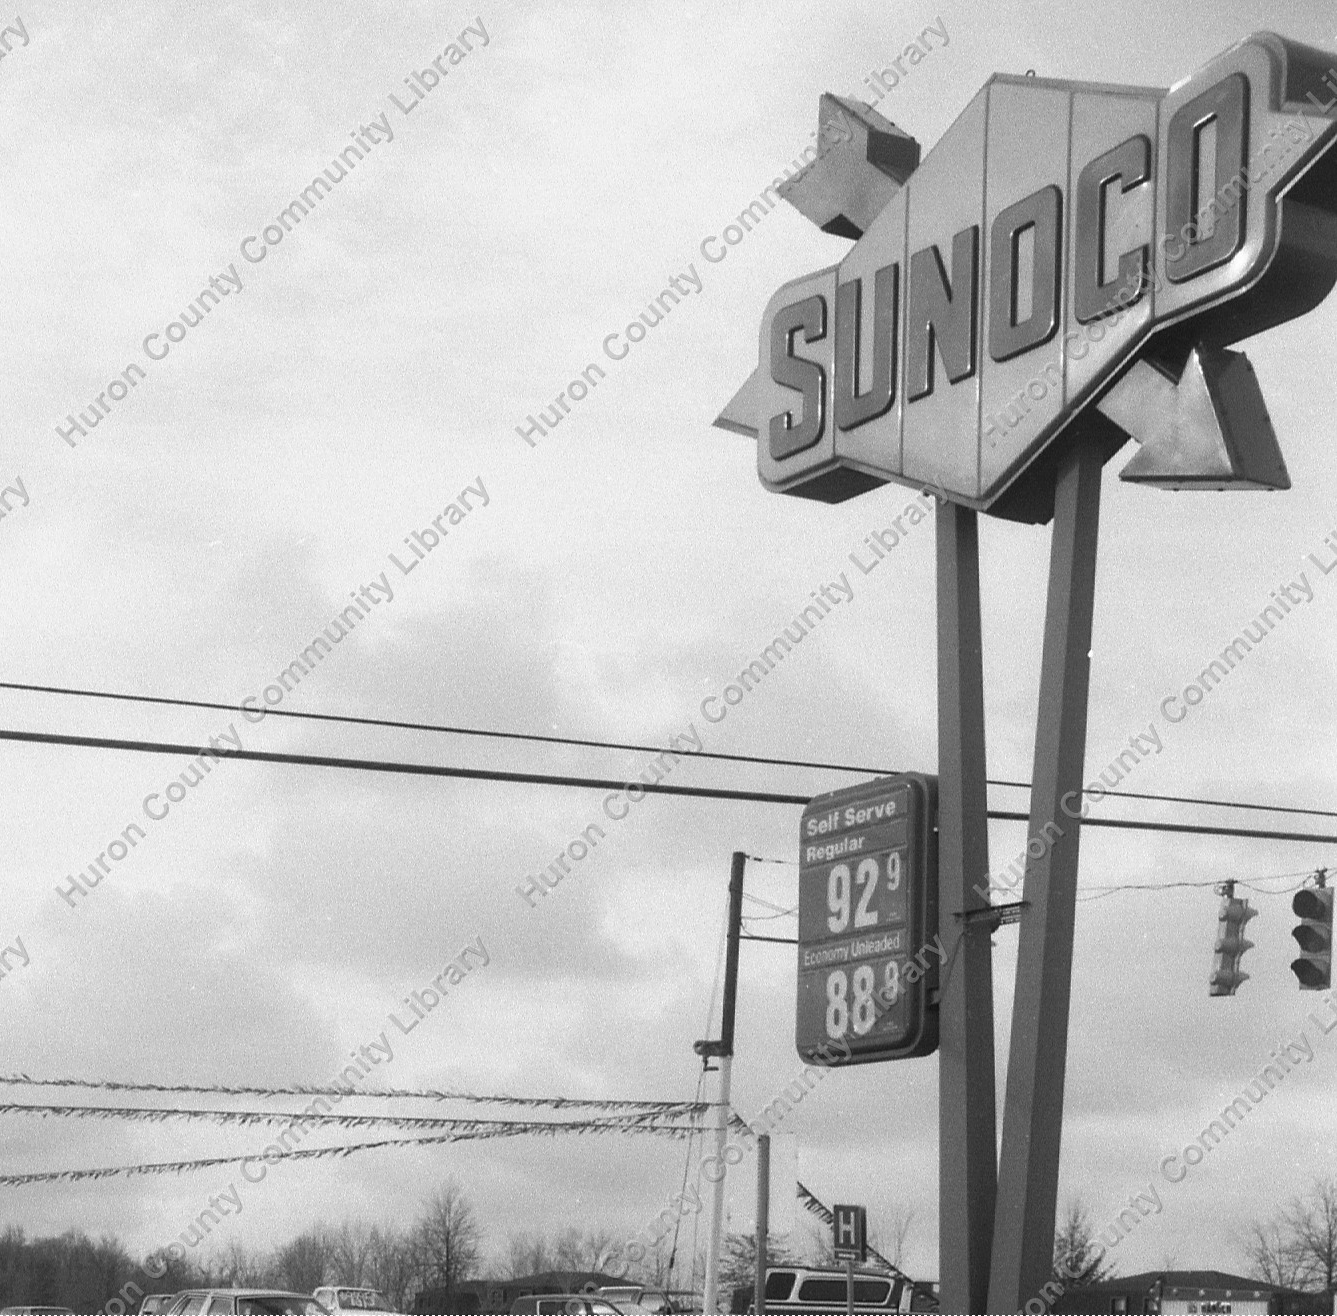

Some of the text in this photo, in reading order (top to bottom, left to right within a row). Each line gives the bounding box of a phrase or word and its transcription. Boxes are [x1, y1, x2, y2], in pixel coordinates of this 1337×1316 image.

[769, 72, 1250, 461] SUNOCO
[807, 800, 896, 836] Self Serve
[807, 834, 865, 862] Regular
[804, 932, 900, 966] Economy Unleaded
[839, 1211, 855, 1245] H
